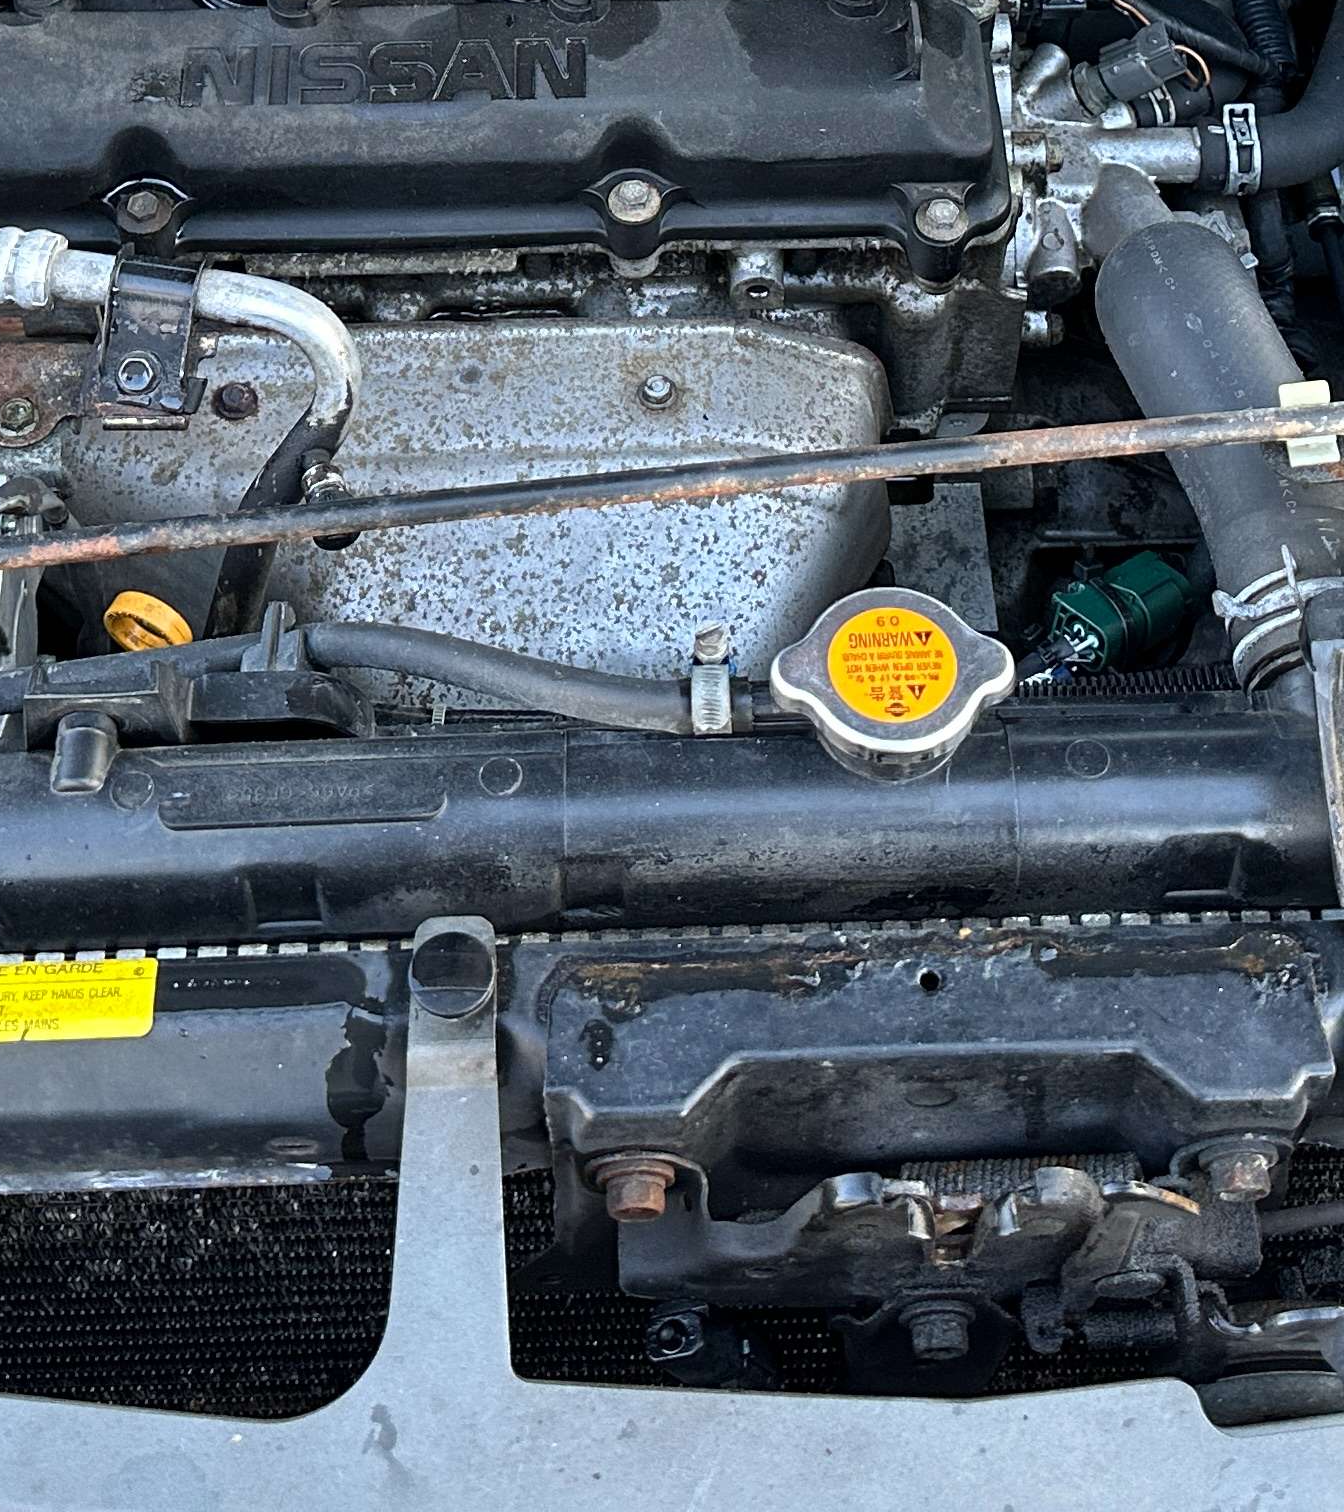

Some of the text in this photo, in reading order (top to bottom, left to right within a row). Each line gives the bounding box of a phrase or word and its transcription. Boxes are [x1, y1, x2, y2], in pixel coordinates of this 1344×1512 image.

[178, 37, 588, 107] NISSAN
[848, 631, 914, 648] WARNING
[15, 965, 37, 976] EN
[44, 963, 105, 975] GARDE
[23, 990, 48, 1001] KEEP
[51, 988, 84, 1000] HANDS
